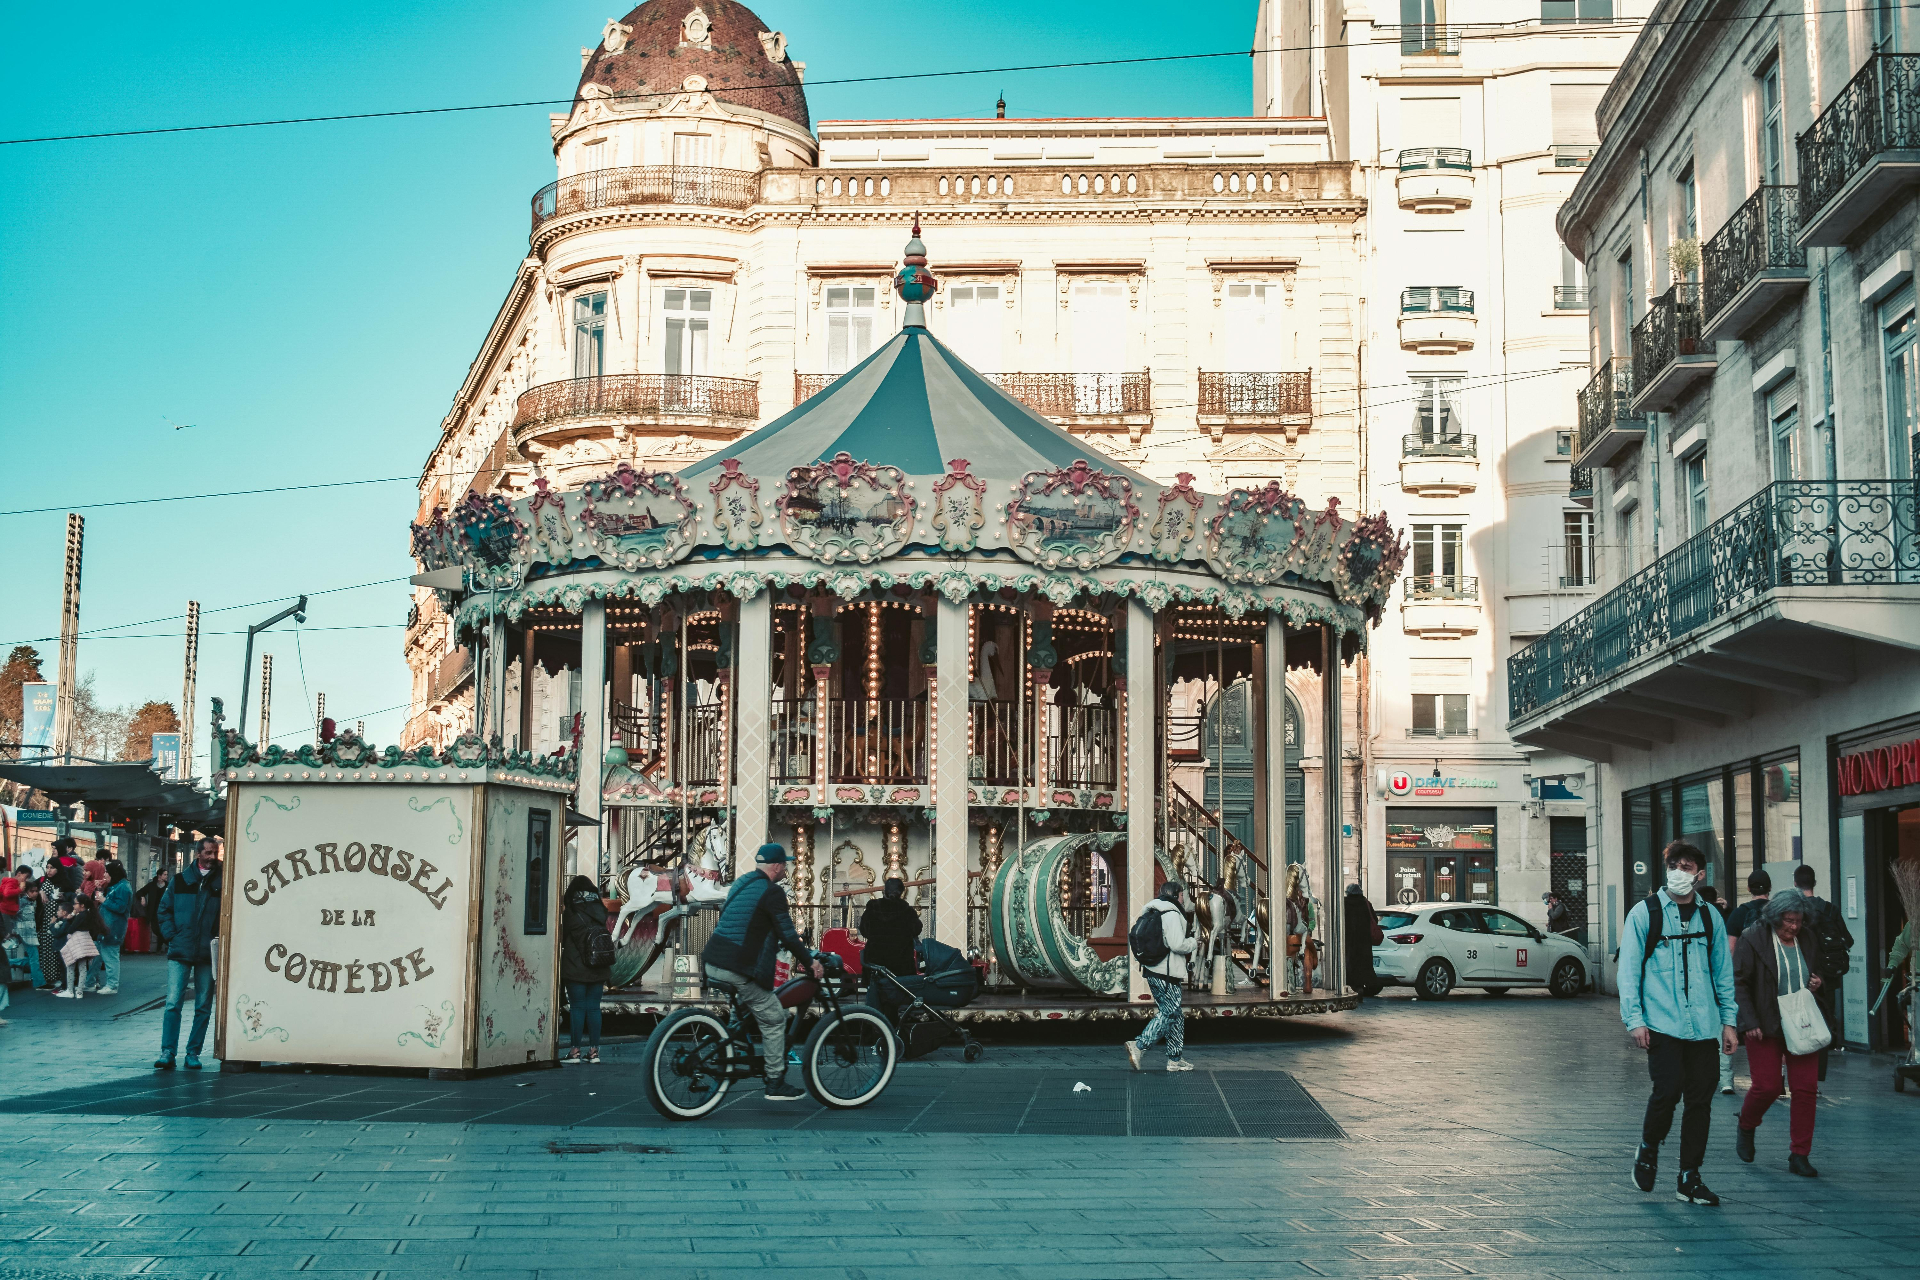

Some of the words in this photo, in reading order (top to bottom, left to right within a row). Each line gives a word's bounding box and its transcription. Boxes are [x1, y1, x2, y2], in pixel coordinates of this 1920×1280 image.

[1394, 777, 1407, 789] U
[1415, 777, 1456, 788] DRIVE
[1458, 777, 1498, 788] Piéton
[243, 841, 454, 911] CARROUSEL
[320, 908, 346, 926] DE
[350, 909, 376, 927] LA
[1466, 950, 1478, 960] 38
[1518, 950, 1526, 961] N
[264, 943, 435, 994] COMÉDIE
